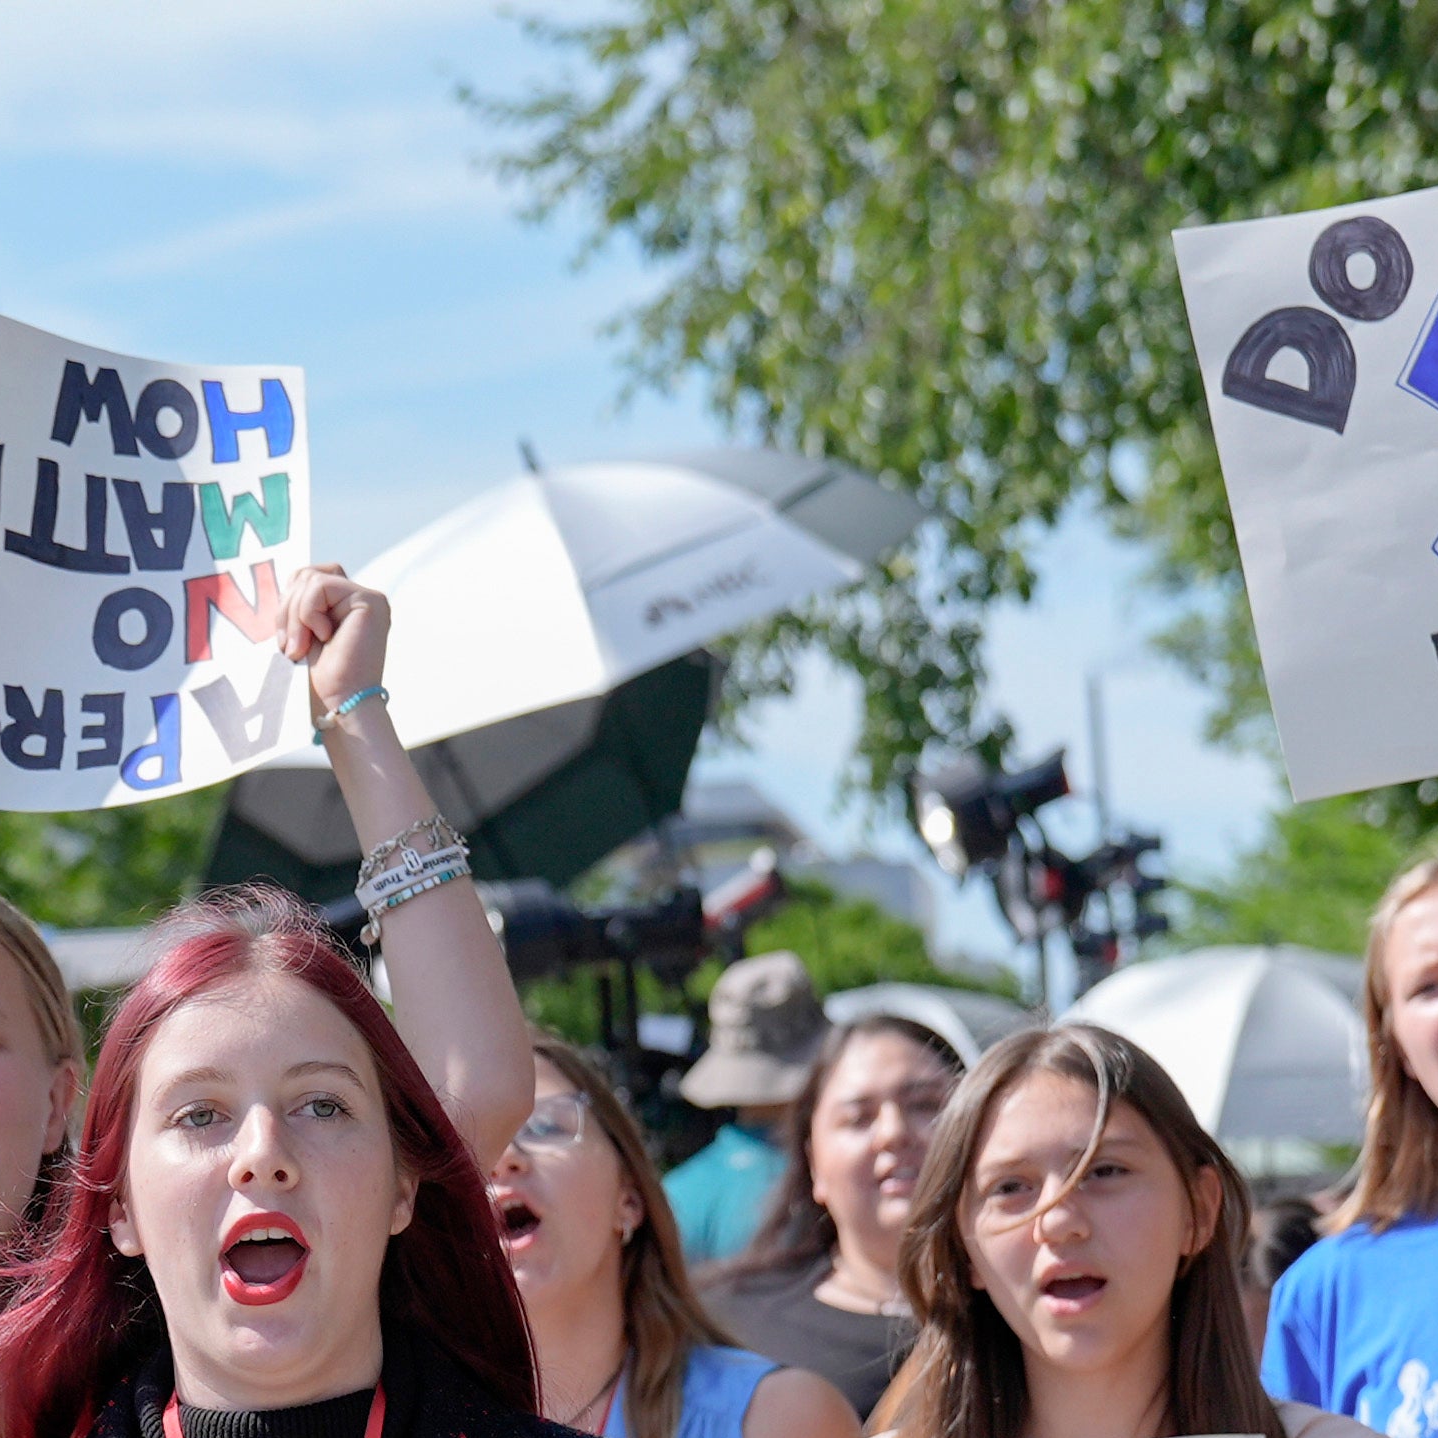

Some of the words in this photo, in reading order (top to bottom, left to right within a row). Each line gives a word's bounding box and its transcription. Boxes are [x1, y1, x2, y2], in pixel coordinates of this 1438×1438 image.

[52, 359, 295, 464] HOW
[94, 560, 279, 670] NO
[190, 652, 293, 765] A
